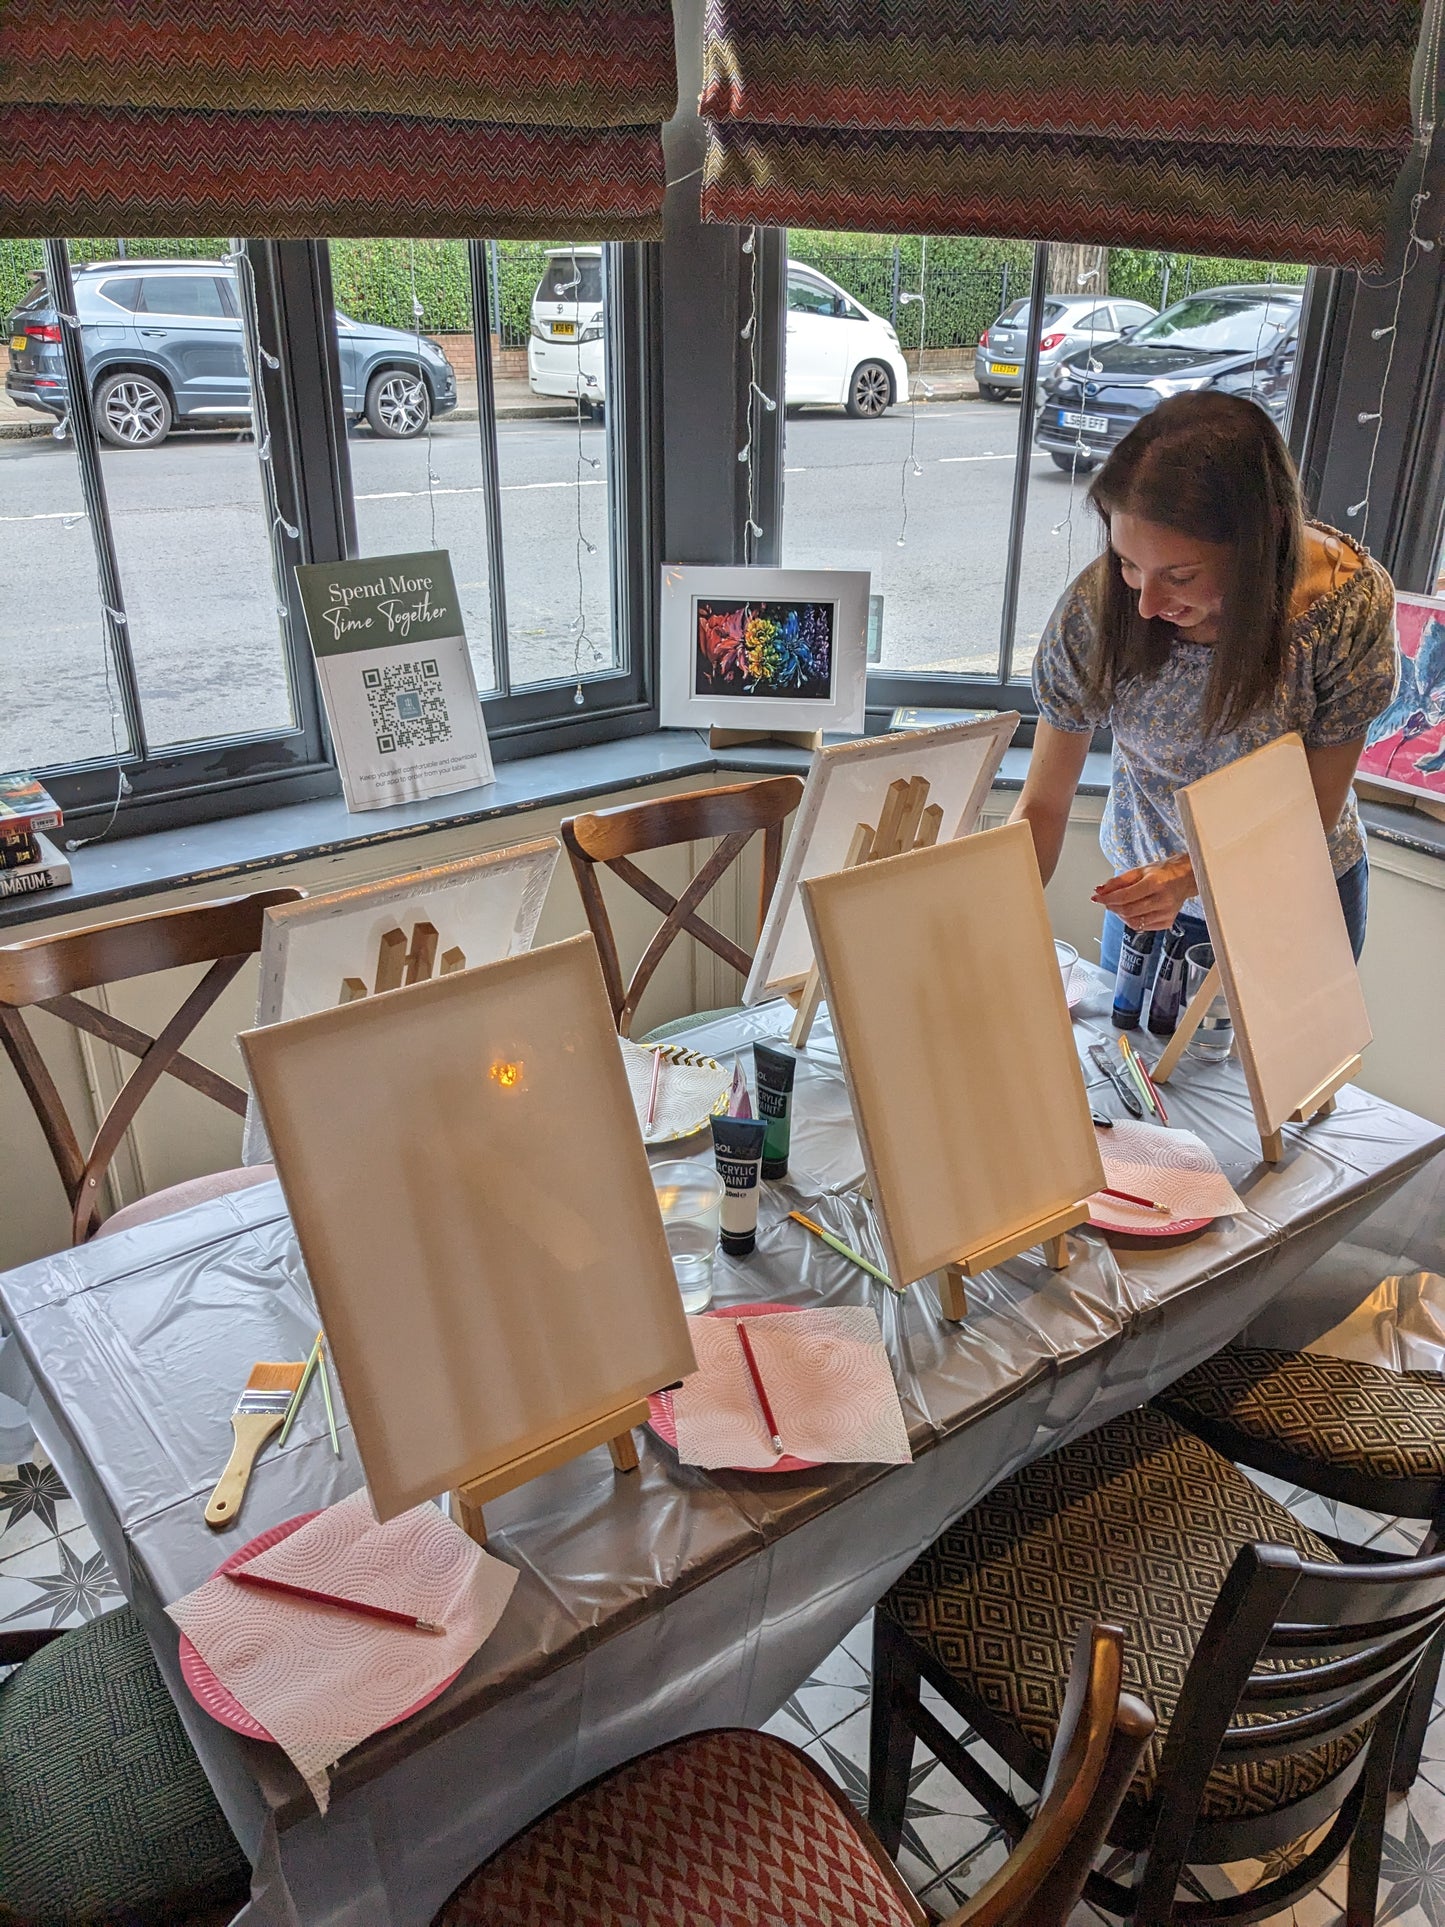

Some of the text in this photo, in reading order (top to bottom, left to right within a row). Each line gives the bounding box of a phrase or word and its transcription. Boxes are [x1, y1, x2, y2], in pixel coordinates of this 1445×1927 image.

[1088, 416, 1106, 430] EFF
[328, 575, 433, 606] Spend More
[322, 591, 447, 640] Time Together
[0, 872, 47, 898] IMATUM
[758, 1090, 785, 1107] CRYLIC
[717, 1162, 755, 1176] ACRYLIC
[721, 1174, 749, 1187] PAINT
